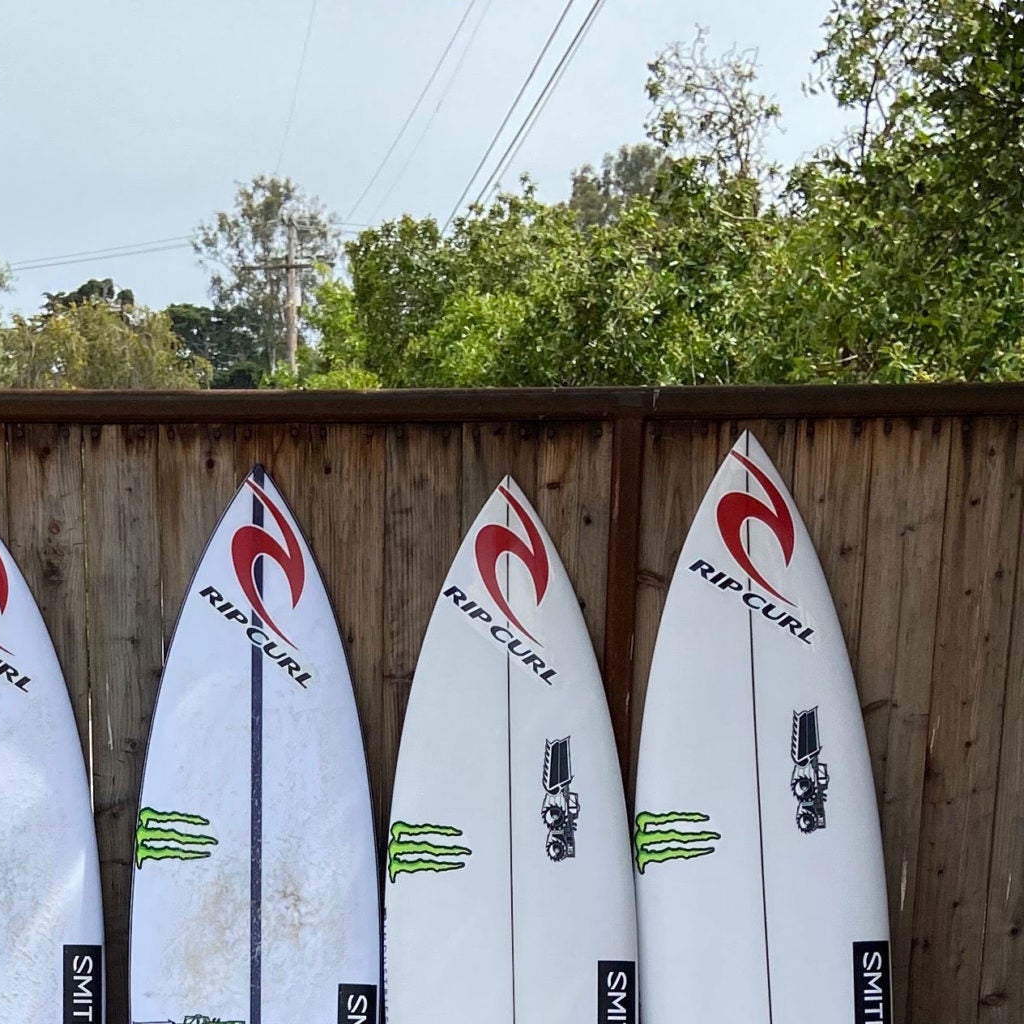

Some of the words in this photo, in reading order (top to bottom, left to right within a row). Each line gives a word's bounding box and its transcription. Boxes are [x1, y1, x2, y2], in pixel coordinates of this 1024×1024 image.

[199, 585, 248, 624] RIP
[246, 627, 312, 689] CURL
[443, 585, 492, 622] RIP
[490, 625, 557, 685] CURL
[688, 559, 743, 591] RIP
[742, 593, 814, 644] CURL
